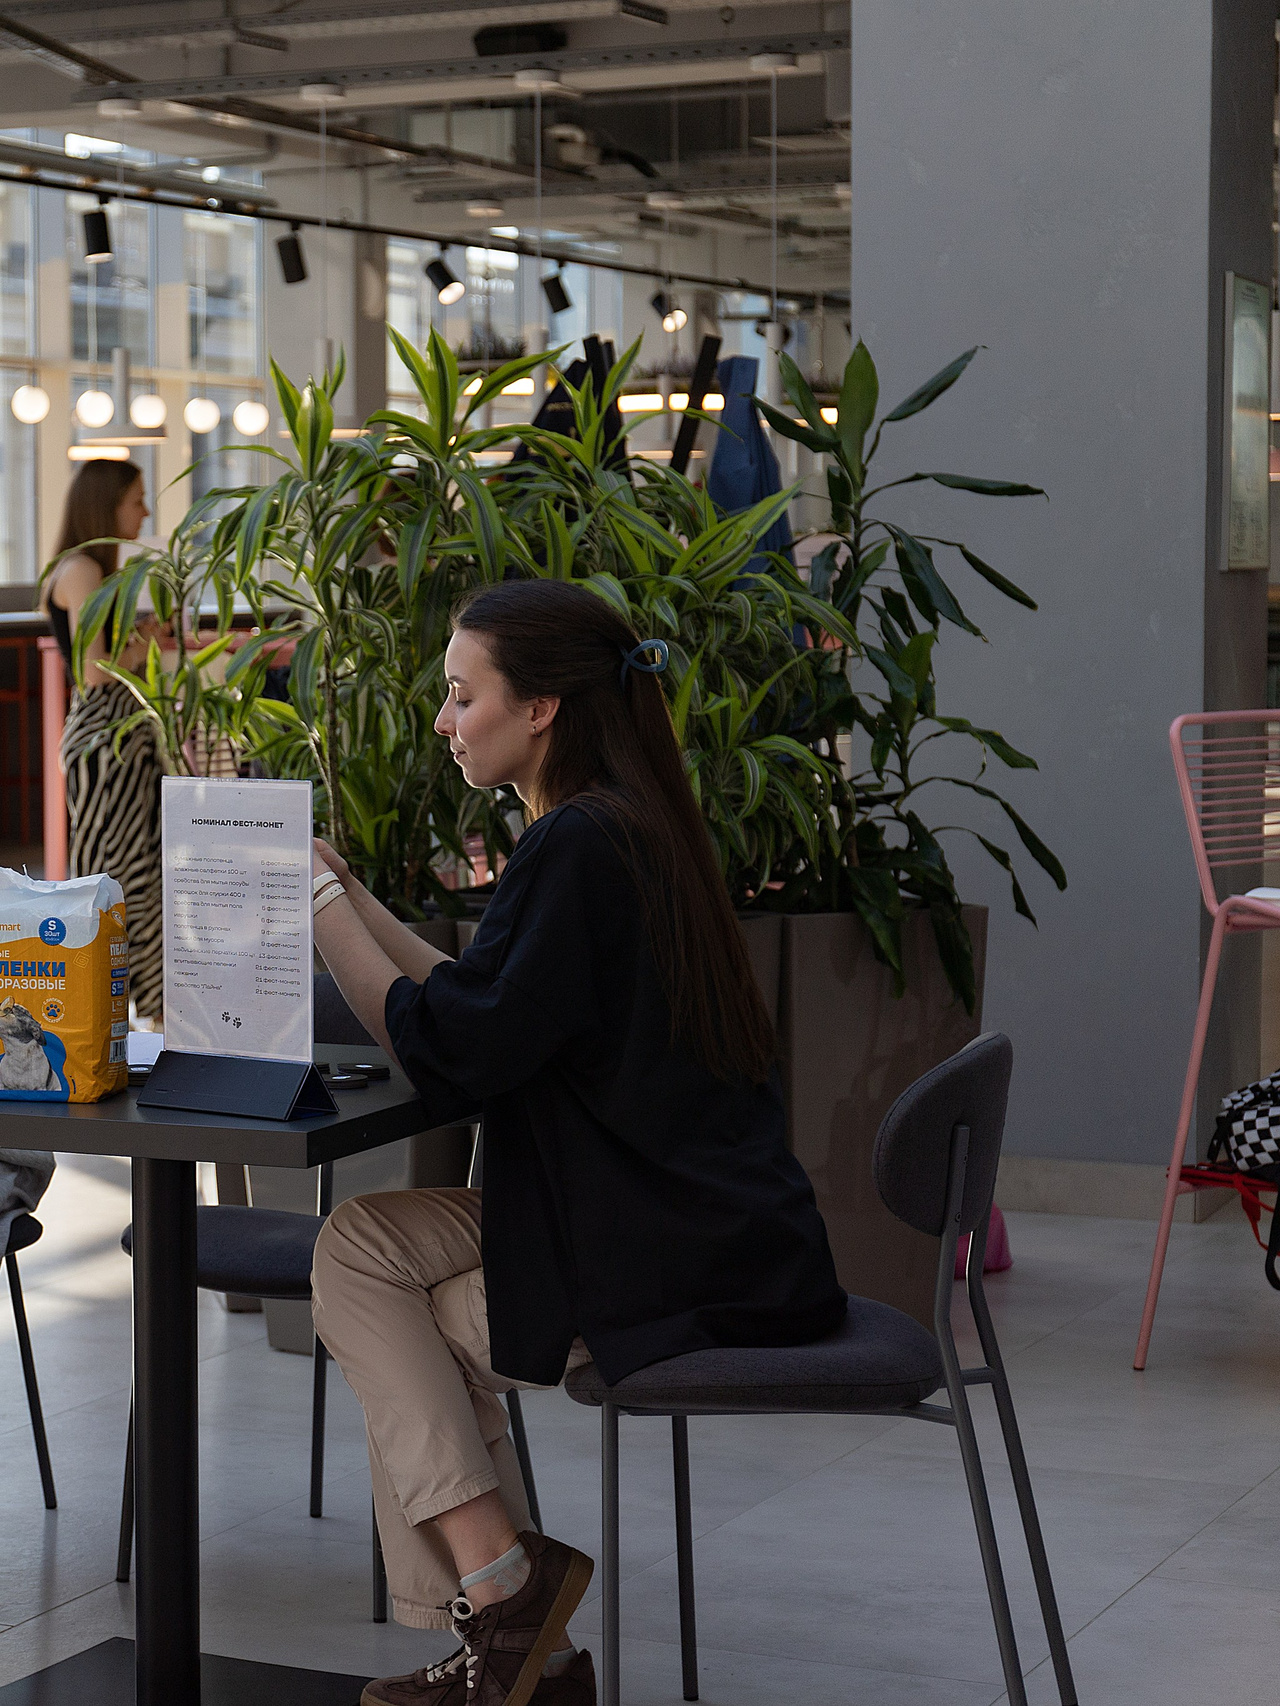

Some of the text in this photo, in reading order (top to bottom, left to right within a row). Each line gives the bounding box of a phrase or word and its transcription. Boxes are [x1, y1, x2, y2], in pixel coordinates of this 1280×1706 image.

[191, 818, 284, 829] НОМИНАЛ ФЕСТ-МОНЕТ
[48, 920, 57, 931] S
